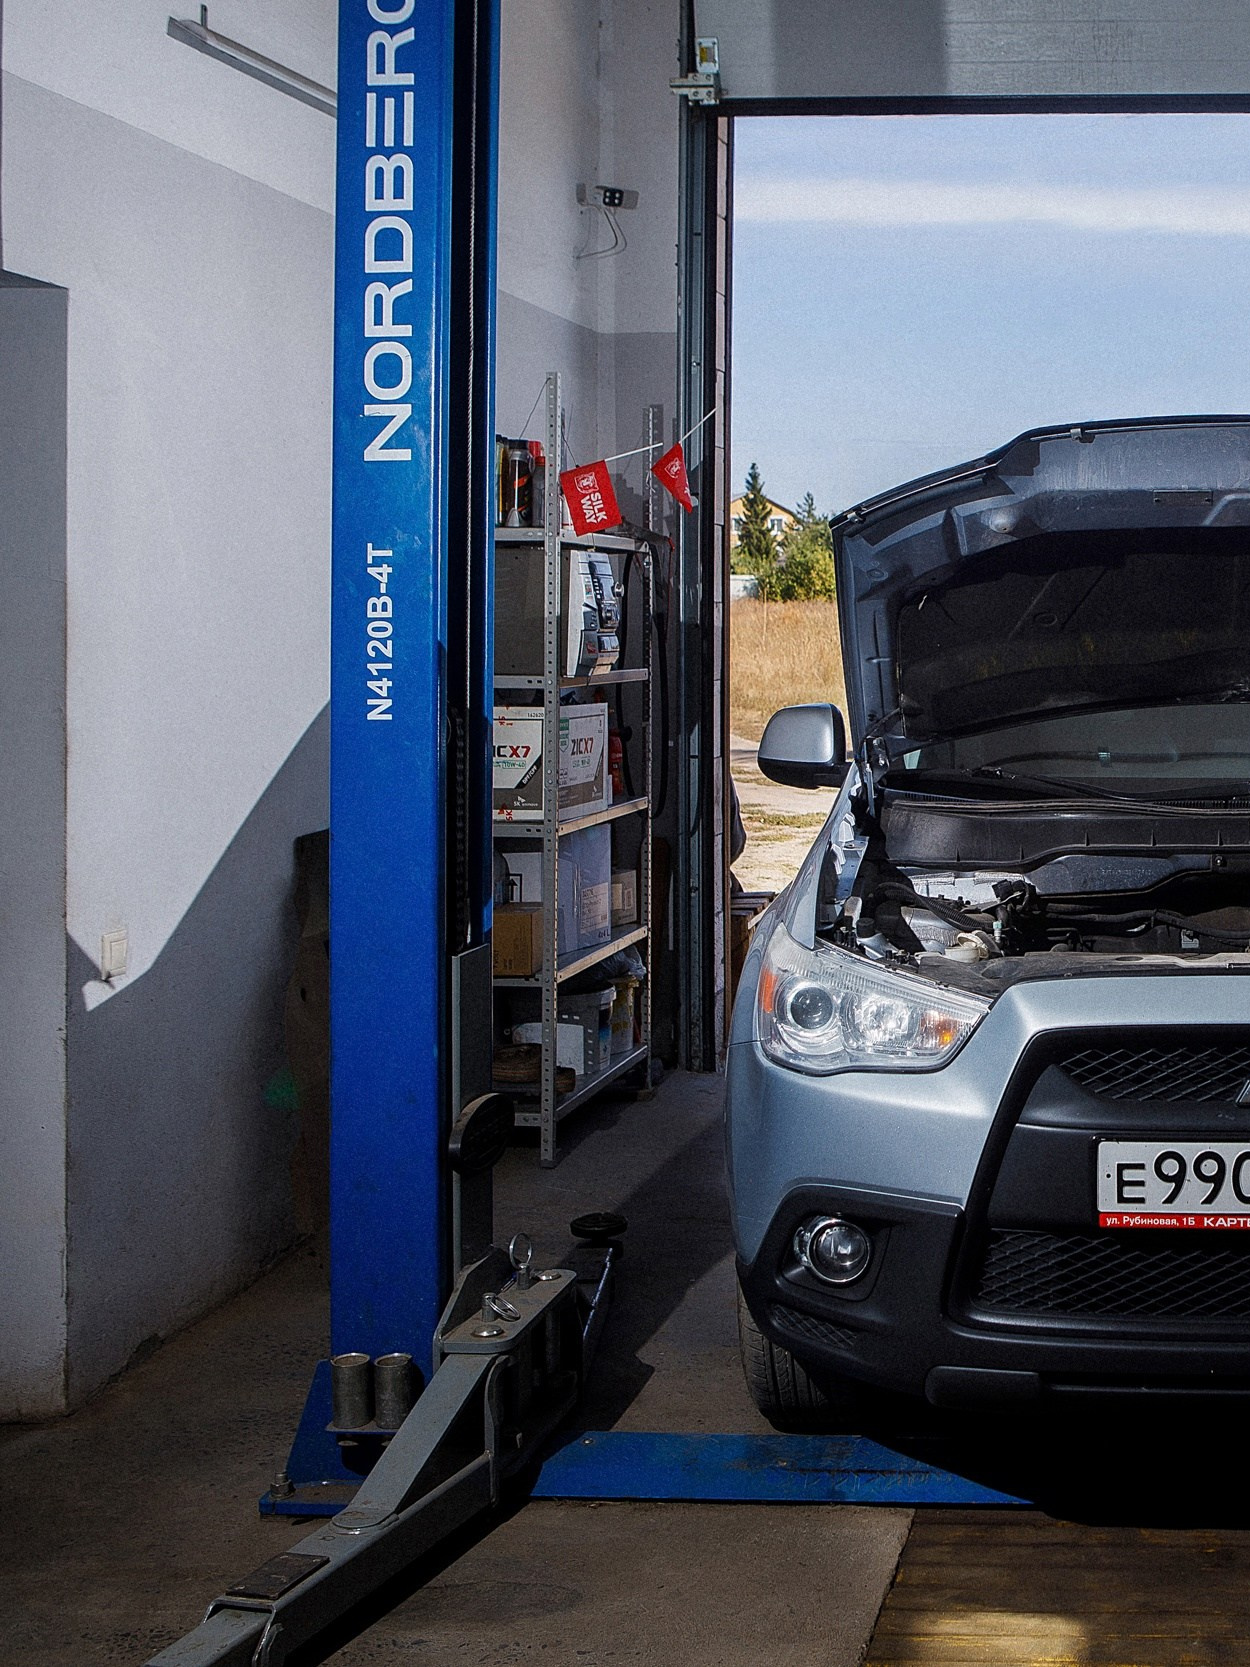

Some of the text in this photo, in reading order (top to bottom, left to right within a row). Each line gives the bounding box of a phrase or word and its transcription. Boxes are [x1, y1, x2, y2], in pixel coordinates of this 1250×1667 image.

[580, 494, 598, 524] WAY
[590, 492, 608, 523] SILK
[366, 542, 393, 721] N4120B-4T
[493, 744, 531, 758] ICX7
[1106, 1217, 1120, 1226] ул.
[1123, 1216, 1179, 1227] Рубиновая,
[1183, 1217, 1195, 1226] 1Б
